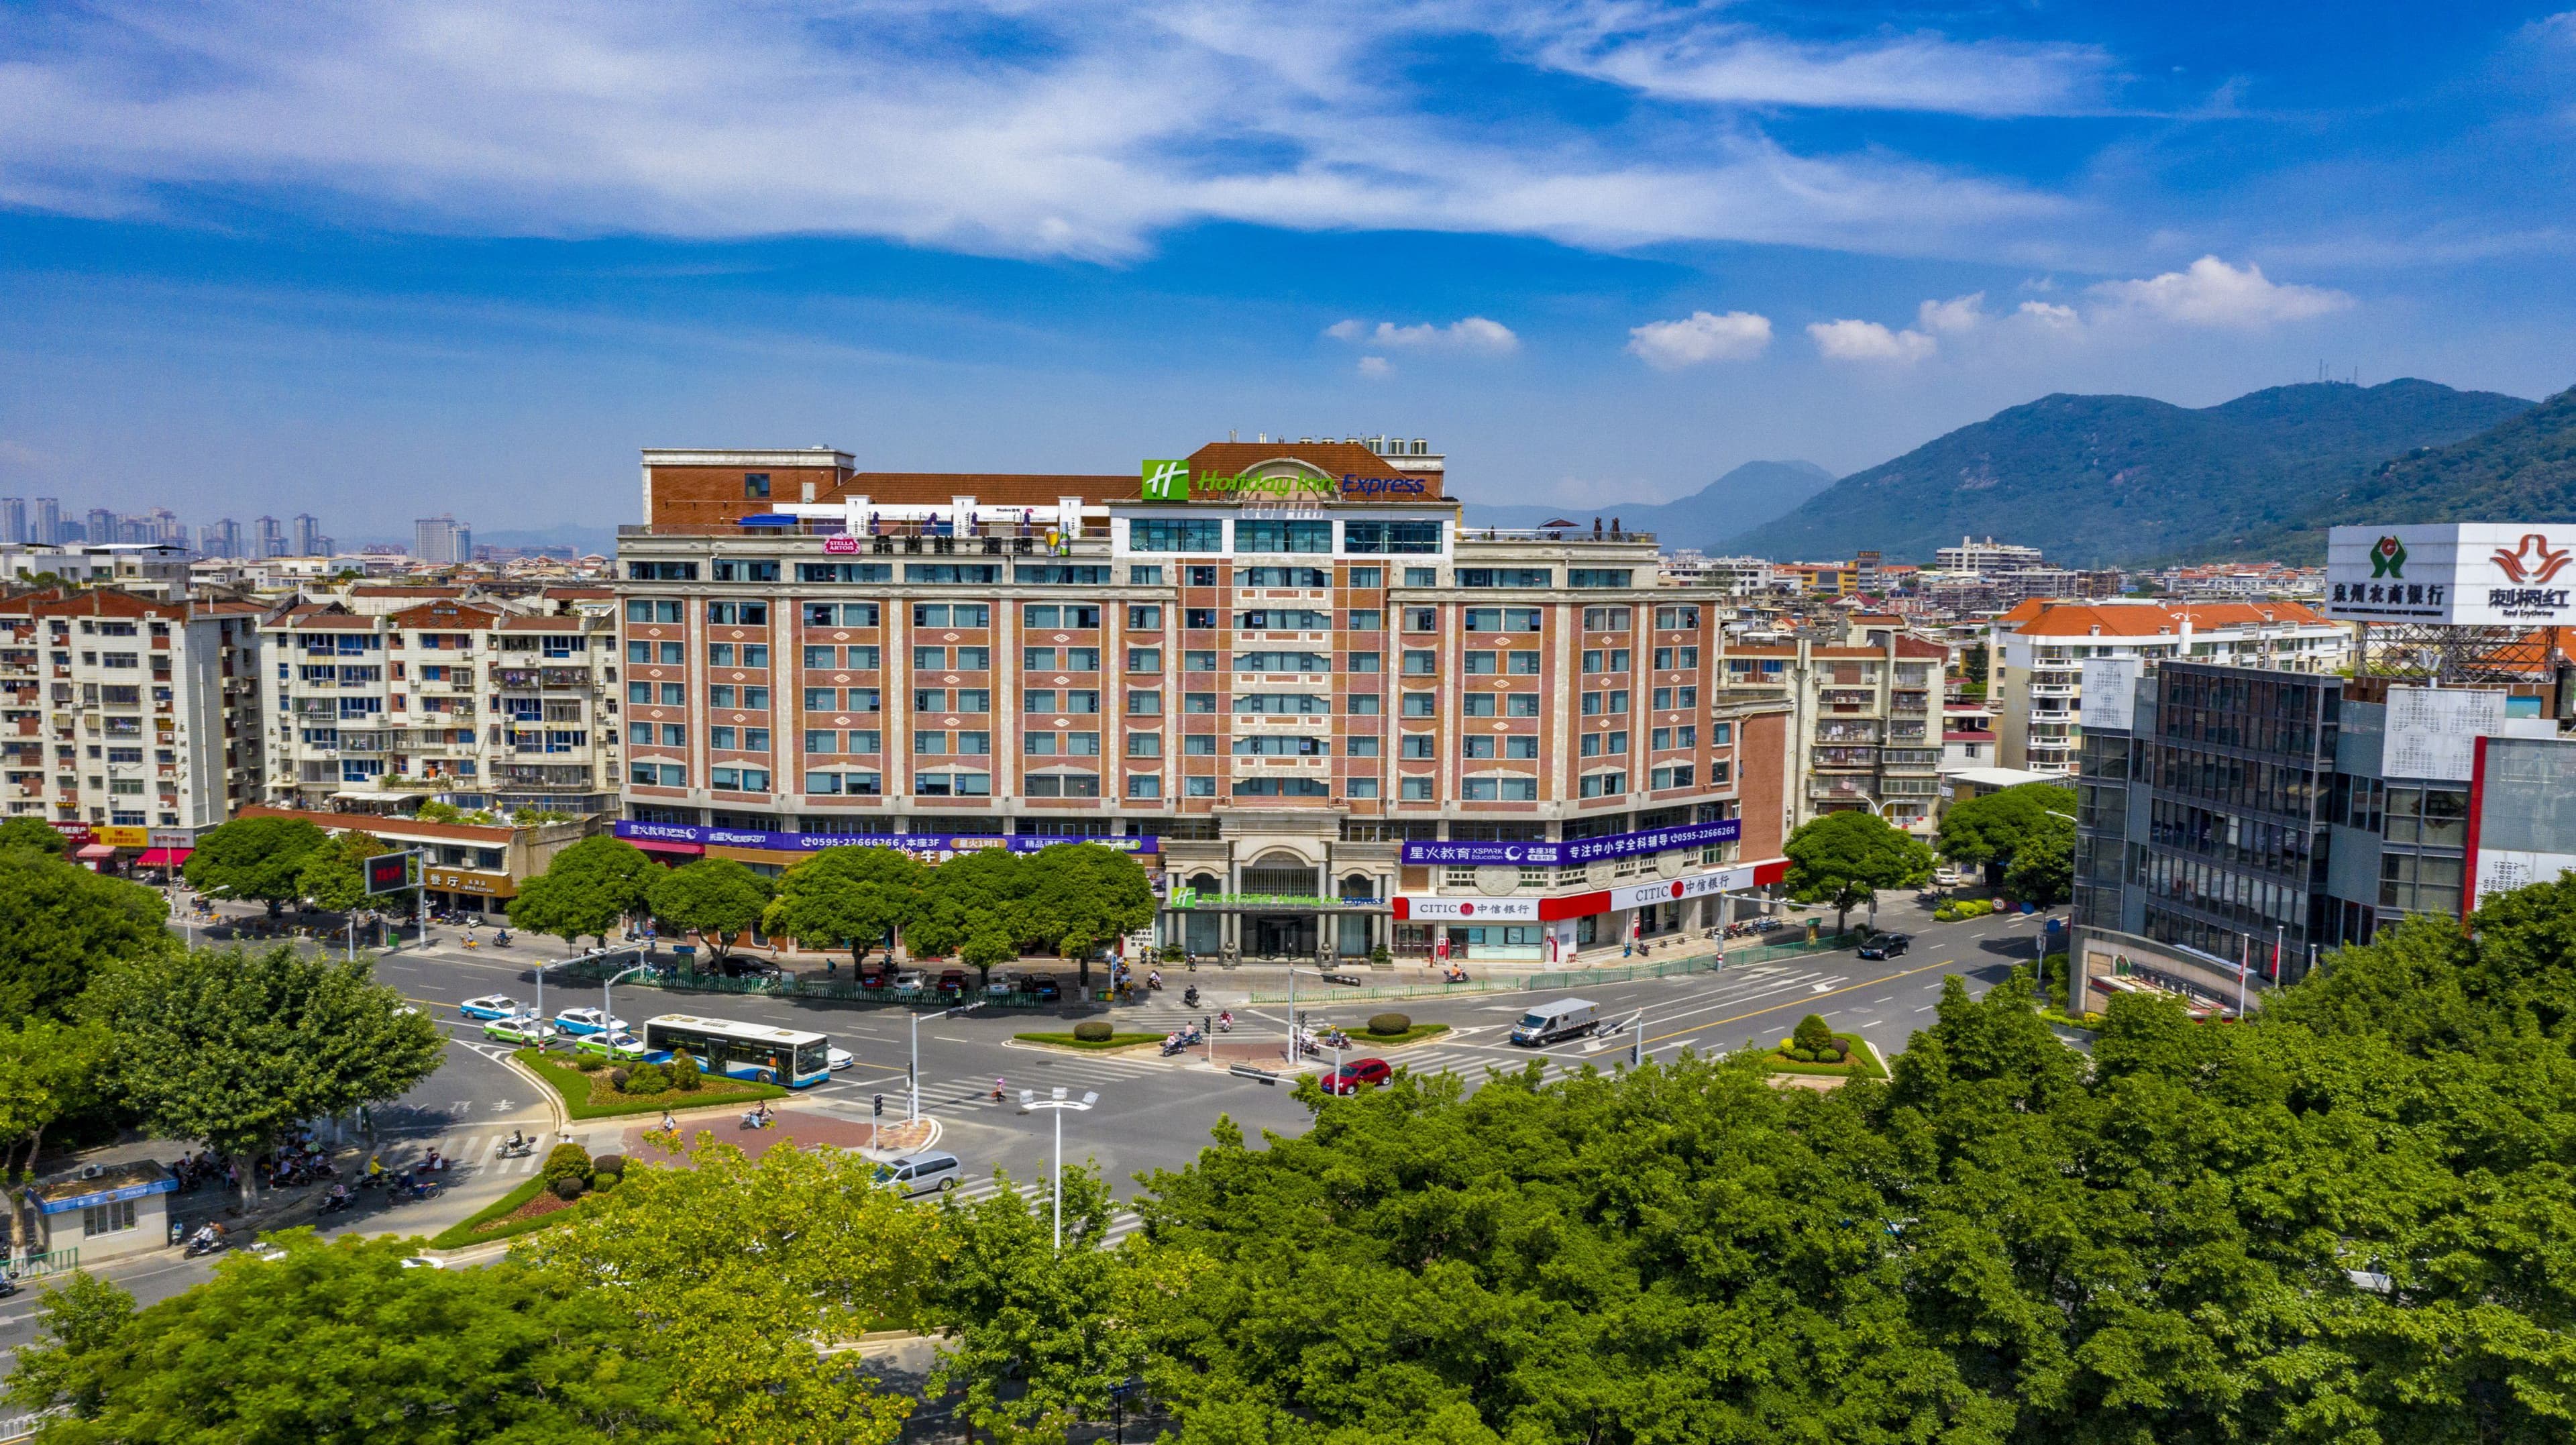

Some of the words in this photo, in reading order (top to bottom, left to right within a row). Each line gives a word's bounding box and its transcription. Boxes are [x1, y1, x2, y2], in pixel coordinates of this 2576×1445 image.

[1197, 470, 1292, 496] Holiday
[1296, 470, 1335, 491] Inn
[1342, 474, 1426, 496] Express
[2332, 583, 2444, 606] 泉州农商银行
[2488, 588, 2570, 608] 刺桐红
[906, 839, 940, 847] 本座3F
[1569, 833, 1668, 859] 专注中小学全科辅导
[1677, 826, 1736, 843] 0595-22666266
[1409, 847, 1471, 860] 星火教育
[1686, 874, 1730, 894] 中信银行
[1635, 886, 1668, 902] CITIC
[1419, 904, 1457, 913] CITIC
[1477, 904, 1530, 914] 中信银行
[125, 1188, 148, 1196] POLICE
